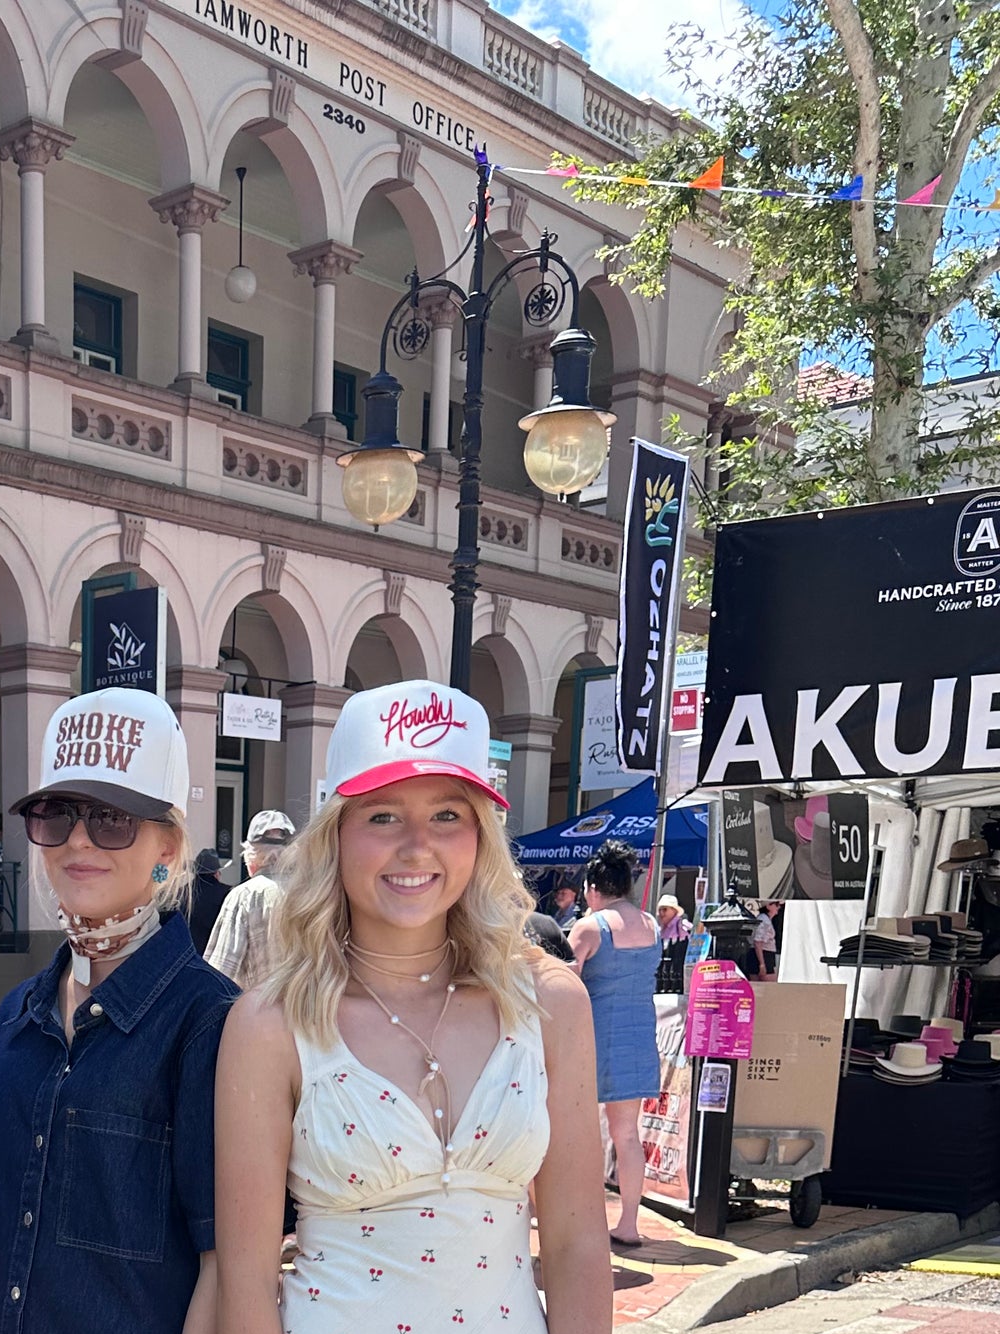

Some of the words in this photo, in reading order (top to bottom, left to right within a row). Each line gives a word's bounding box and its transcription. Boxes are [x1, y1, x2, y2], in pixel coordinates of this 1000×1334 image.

[340, 63, 387, 107] POST
[412, 101, 476, 152] OFFICE
[322, 103, 367, 135] 2340
[878, 579, 996, 603] HANDCRAFTED
[935, 599, 973, 613] Since
[676, 656, 699, 665] ARALLEL
[96, 670, 153, 687] BOTANIQUE
[679, 692, 689, 704] NO
[673, 705, 695, 716] STOPPING
[380, 691, 467, 749] Howdy
[56, 711, 146, 748] SMOKE
[53, 741, 136, 773] SHOW
[617, 815, 658, 829] RSL
[606, 829, 647, 837] NSW
[518, 845, 570, 859] Tamworth
